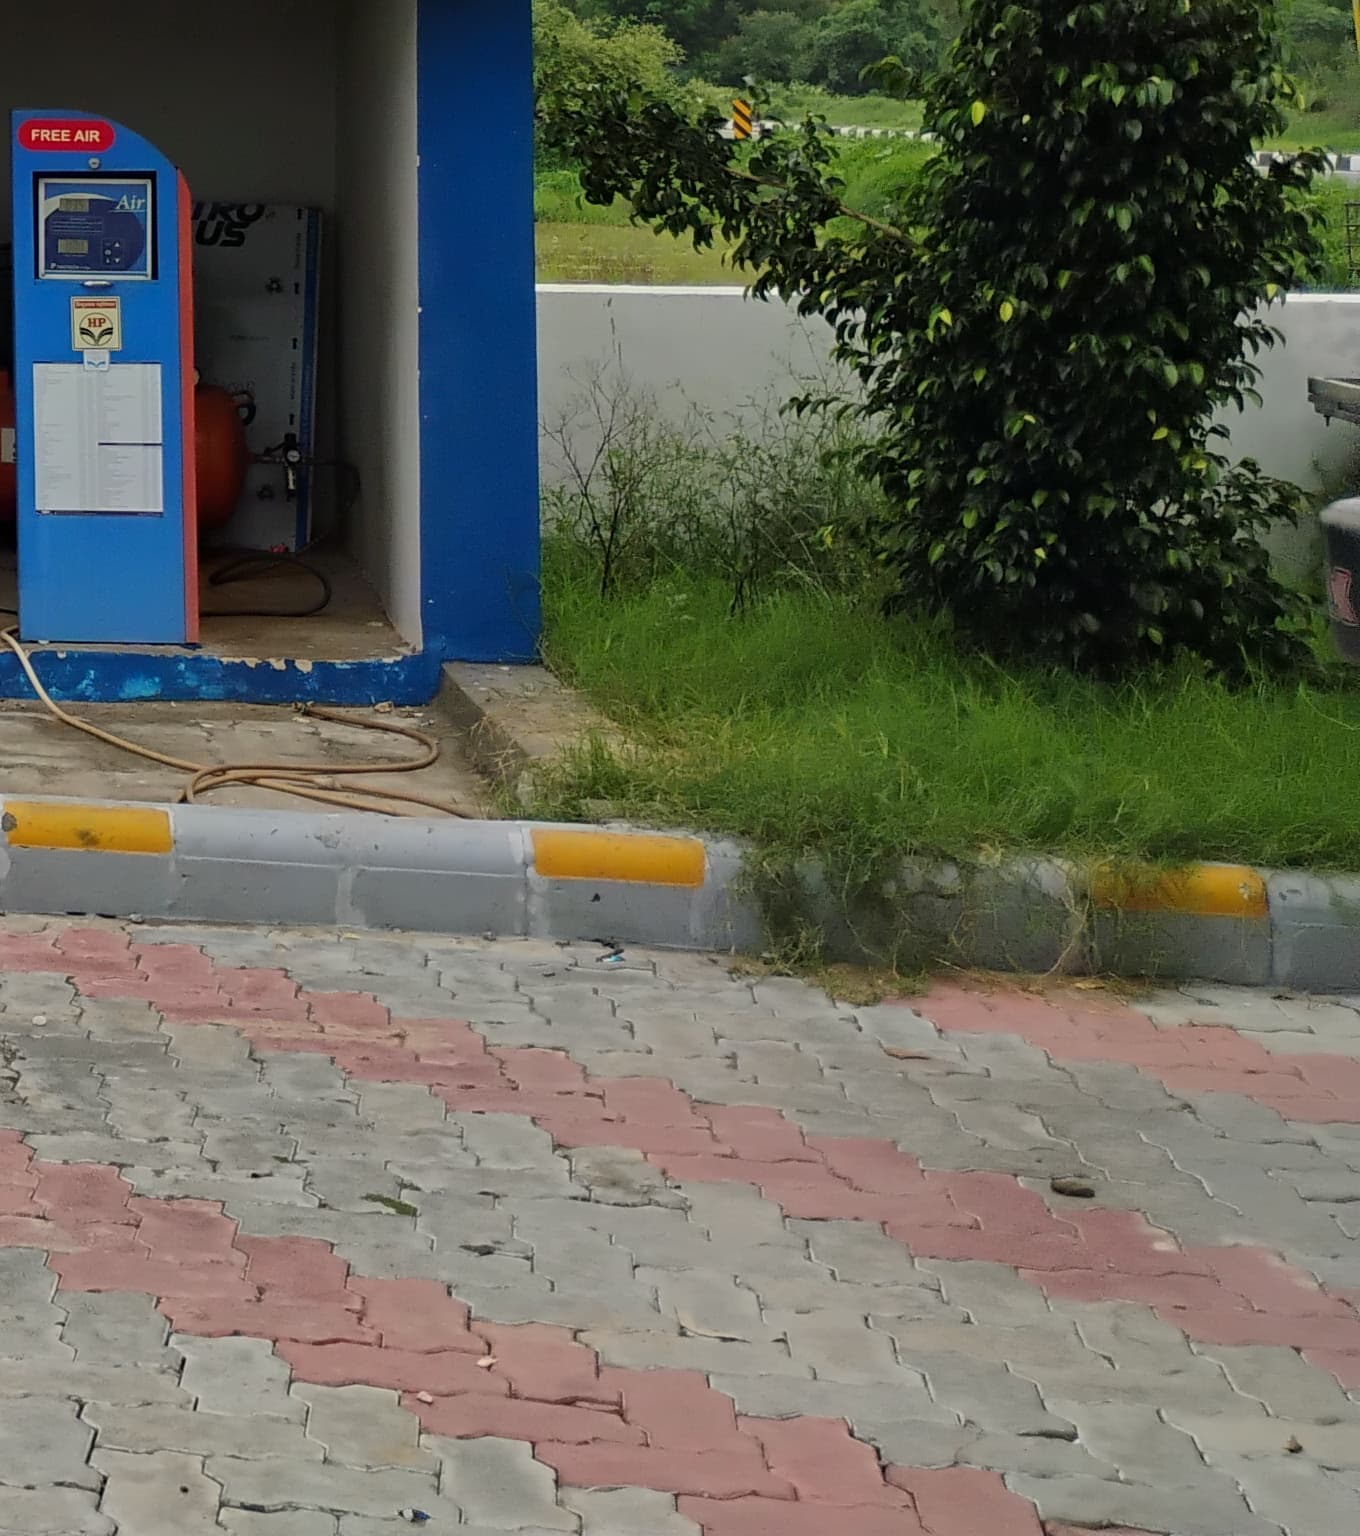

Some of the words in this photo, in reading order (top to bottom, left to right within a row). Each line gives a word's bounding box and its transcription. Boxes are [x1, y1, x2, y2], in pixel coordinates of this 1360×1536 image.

[30, 128, 71, 142] FREE
[73, 129, 100, 143] AIR
[115, 194, 146, 210] Air
[87, 317, 107, 328] HP
